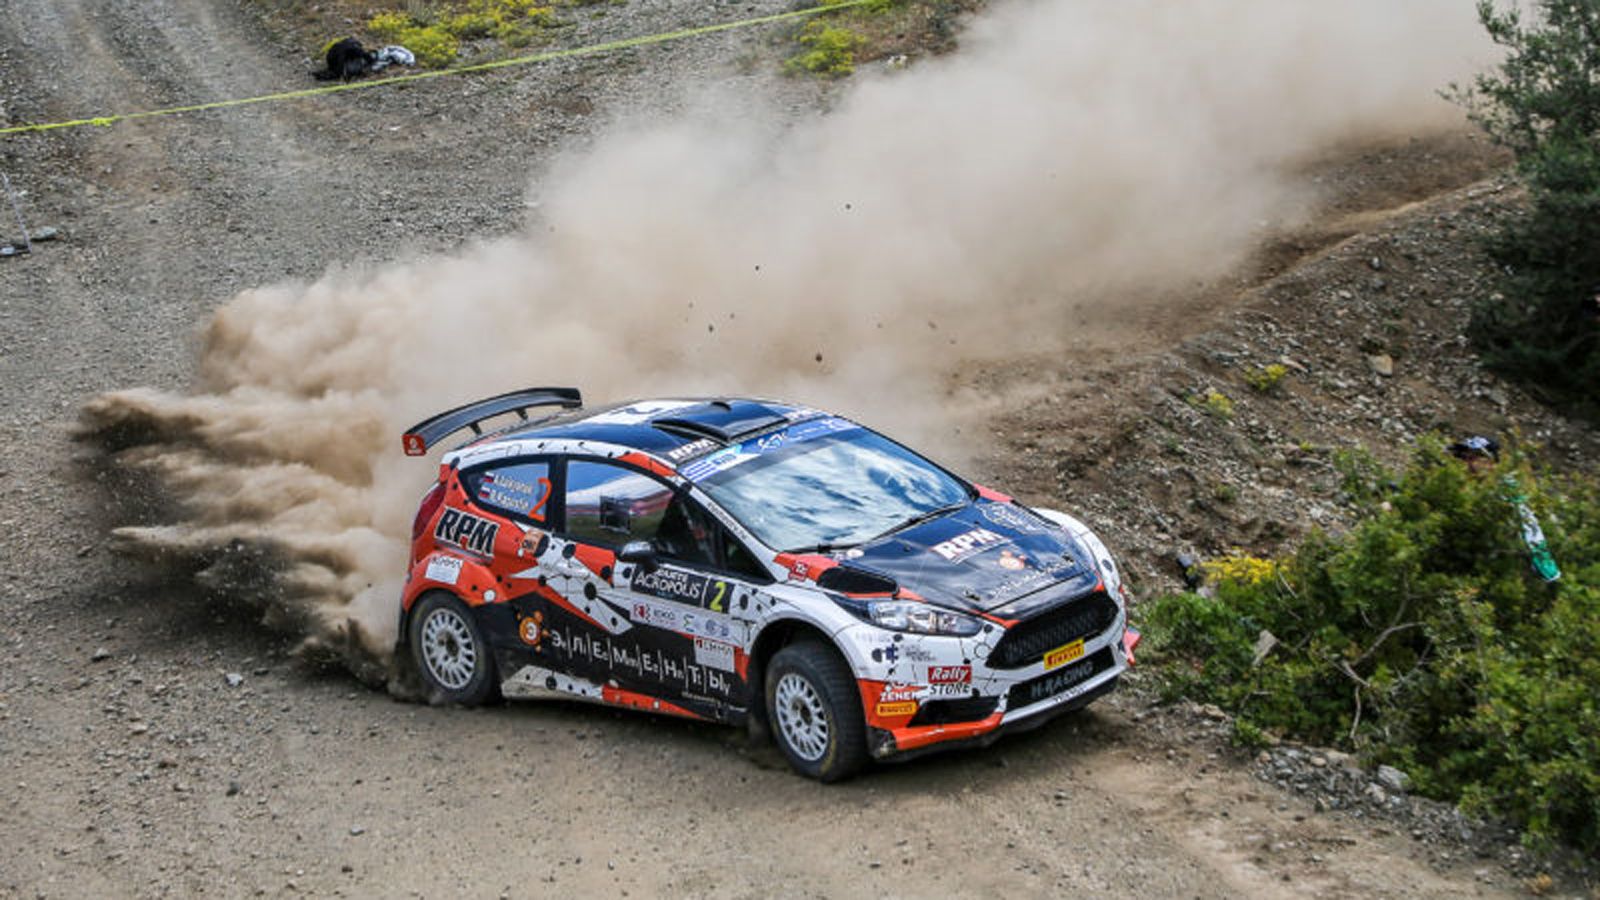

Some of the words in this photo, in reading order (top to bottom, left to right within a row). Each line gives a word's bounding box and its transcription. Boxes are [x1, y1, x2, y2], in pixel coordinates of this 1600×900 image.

[668, 436, 718, 459] RPM
[528, 477, 552, 522] 2
[434, 506, 499, 557] RPM
[930, 528, 1004, 561] RPM
[634, 571, 701, 599] ACROPOLIS
[709, 580, 727, 612] 2
[930, 683, 971, 695] STORE
[931, 667, 970, 681] Rally
